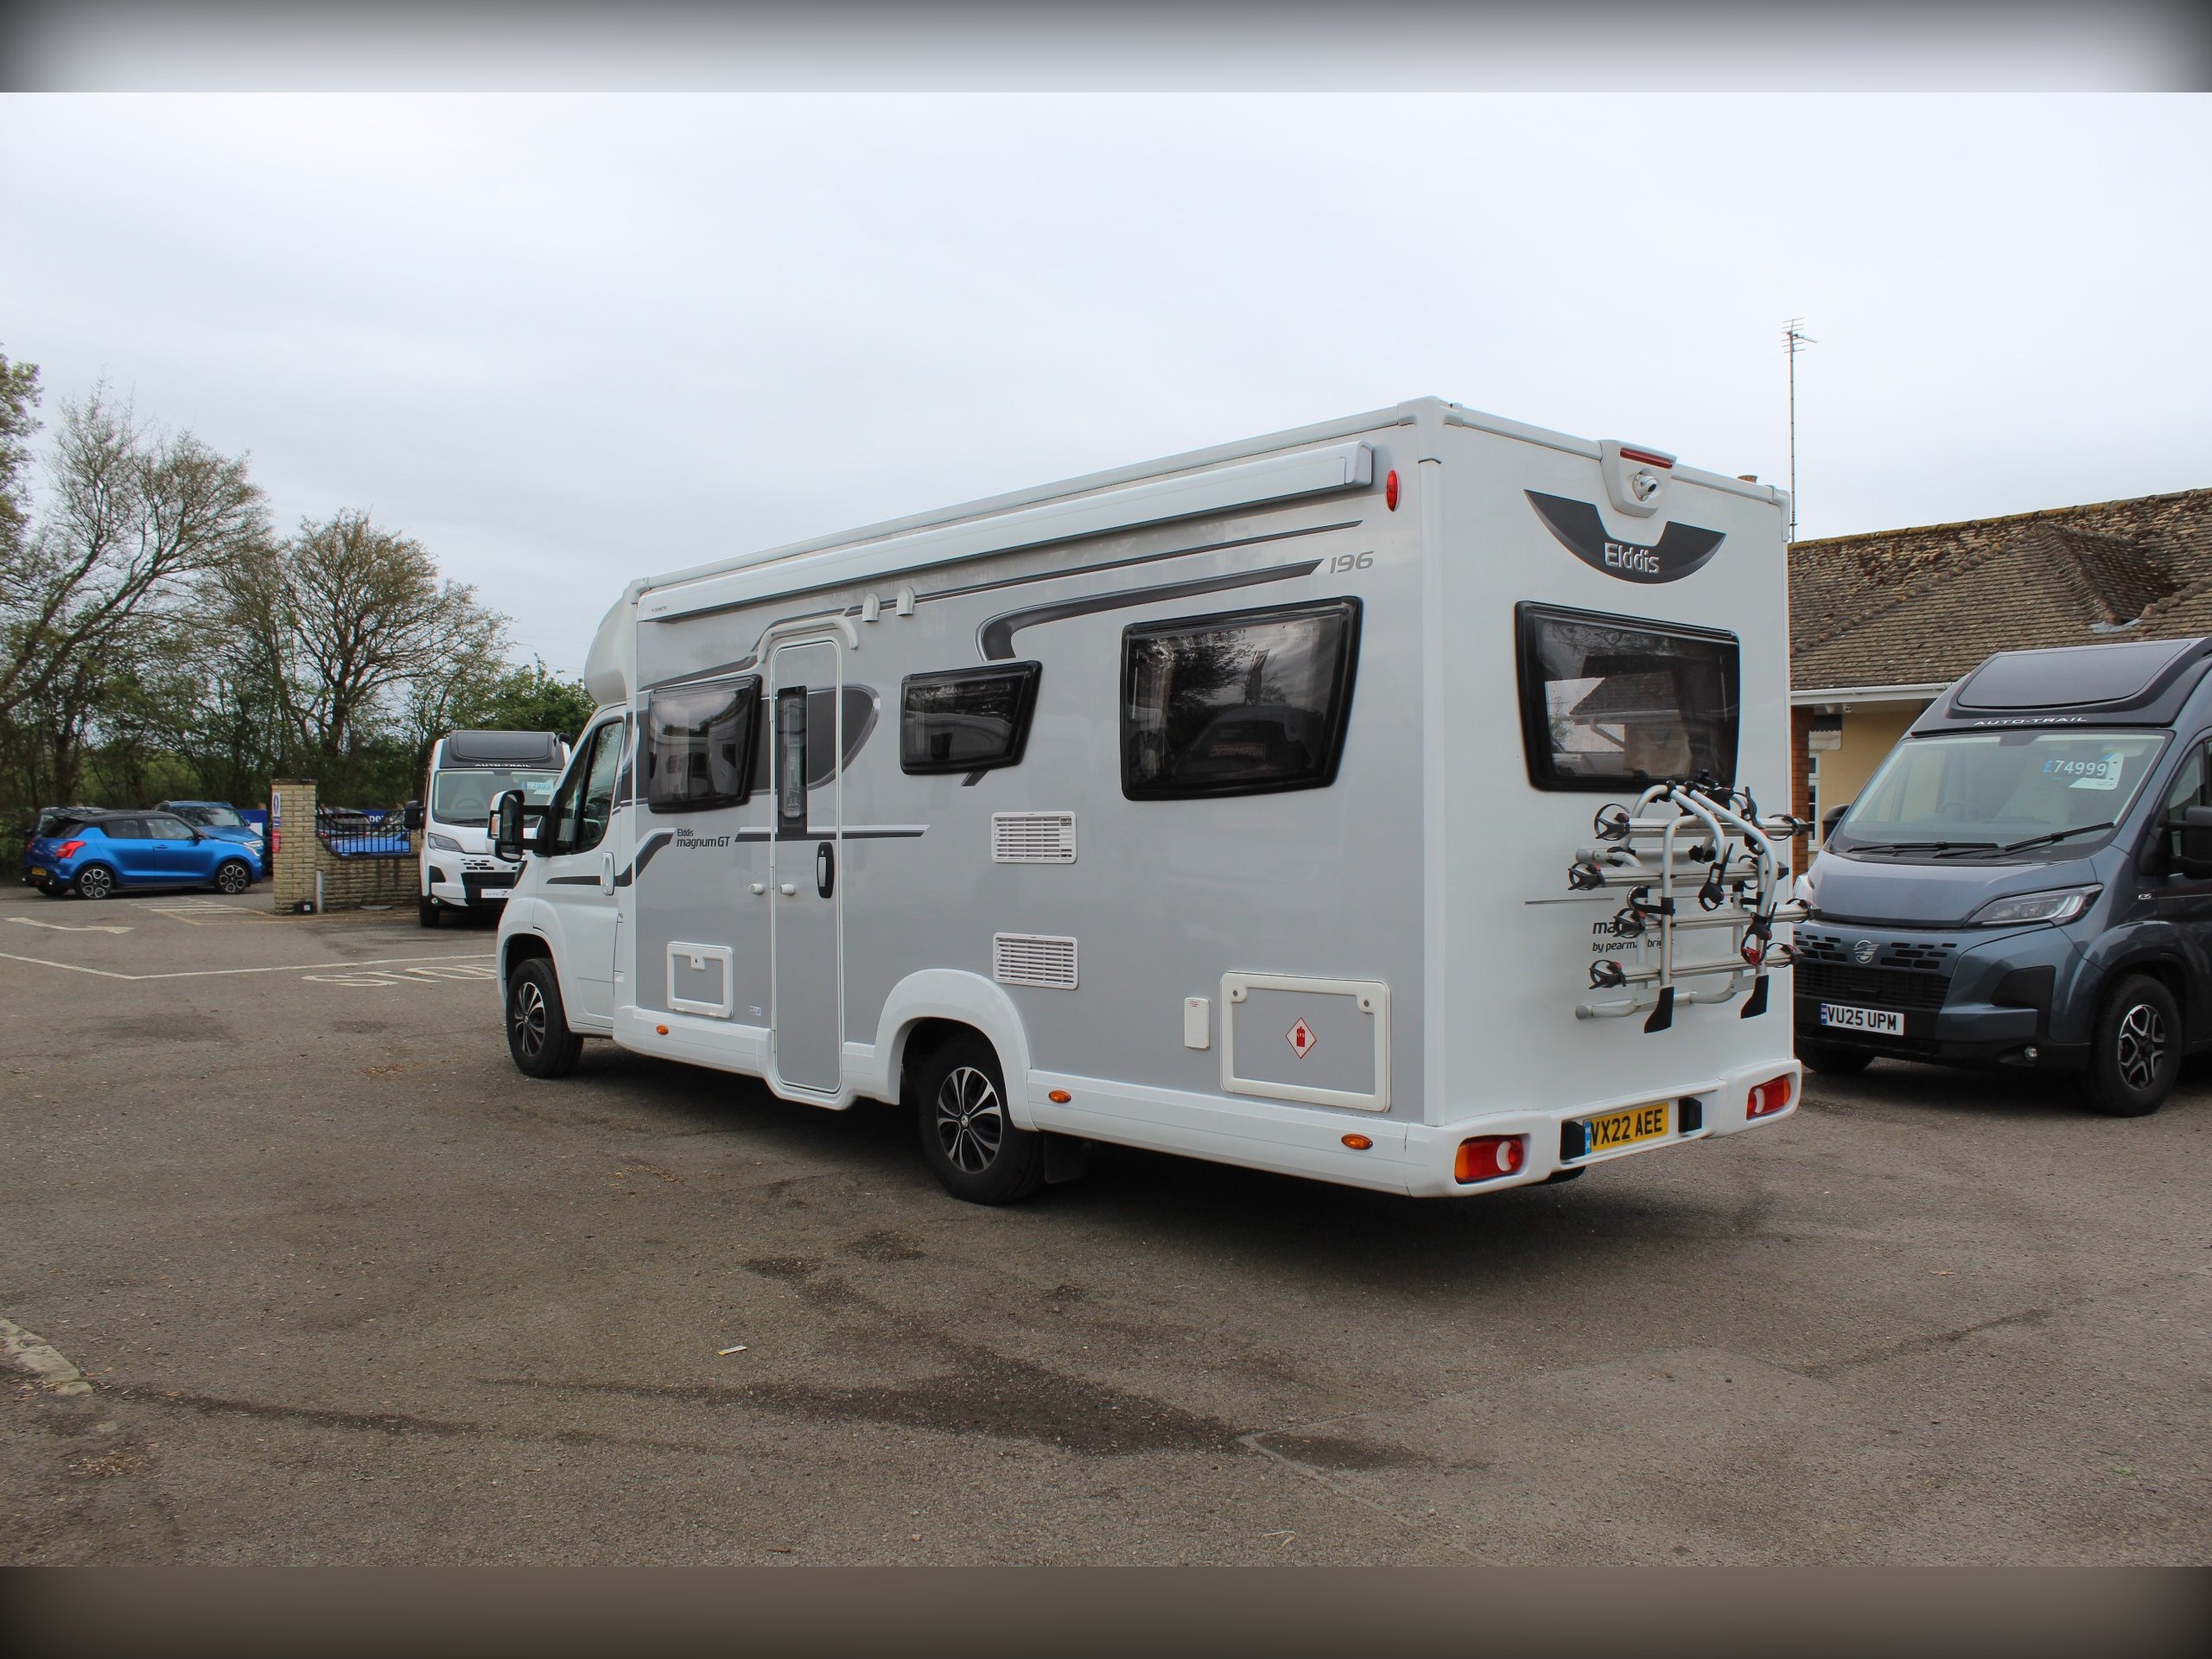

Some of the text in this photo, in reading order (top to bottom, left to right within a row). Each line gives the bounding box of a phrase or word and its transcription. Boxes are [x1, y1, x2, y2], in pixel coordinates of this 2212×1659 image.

[1330, 550, 1375, 575] 196
[1605, 542, 1660, 575] Elddis
[1974, 716, 2088, 726] AUTO-TRAIL
[2043, 760, 2107, 777] £74999
[677, 828, 694, 837] Elddis
[677, 836, 731, 849] magnum GT
[1592, 942, 1604, 953] by
[1605, 940, 1637, 952] pearm
[1827, 1006, 1897, 1031] VU25 UPM
[1590, 1108, 1663, 1147] VX22 AEE
